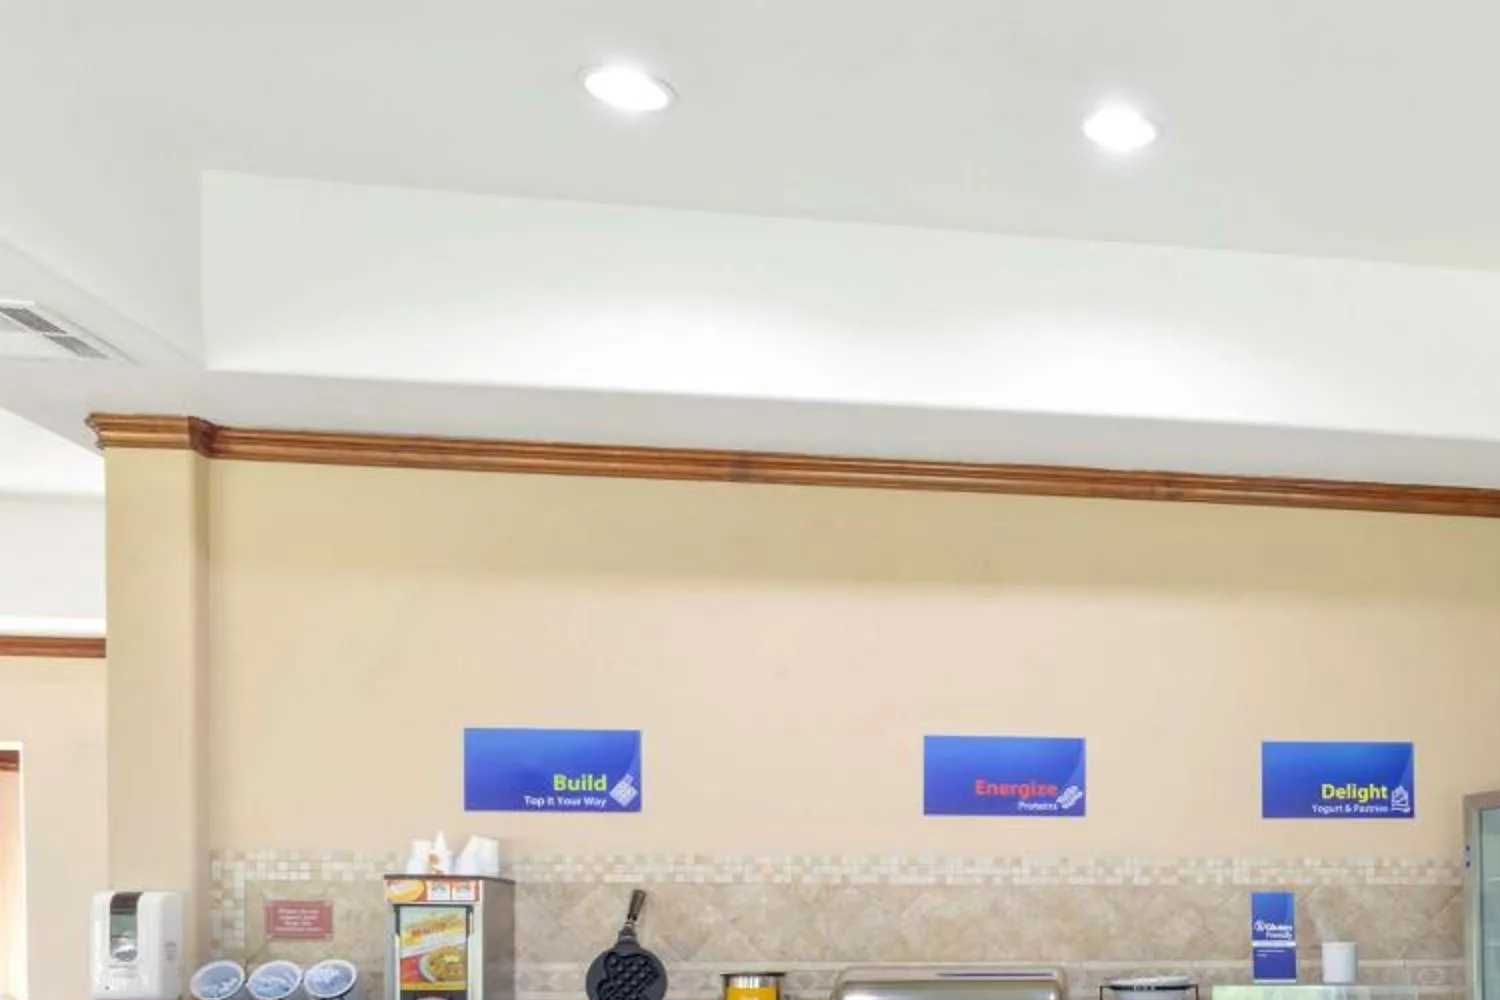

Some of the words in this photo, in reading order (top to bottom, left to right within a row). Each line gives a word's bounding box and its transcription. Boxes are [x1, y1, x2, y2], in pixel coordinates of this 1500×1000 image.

[553, 773, 607, 791] Build
[975, 779, 1059, 800] Energize
[523, 795, 545, 808] Top
[557, 795, 581, 806] Your
[583, 795, 607, 808] Way
[1321, 783, 1389, 802] Delight
[1311, 803, 1343, 815] Yogurt
